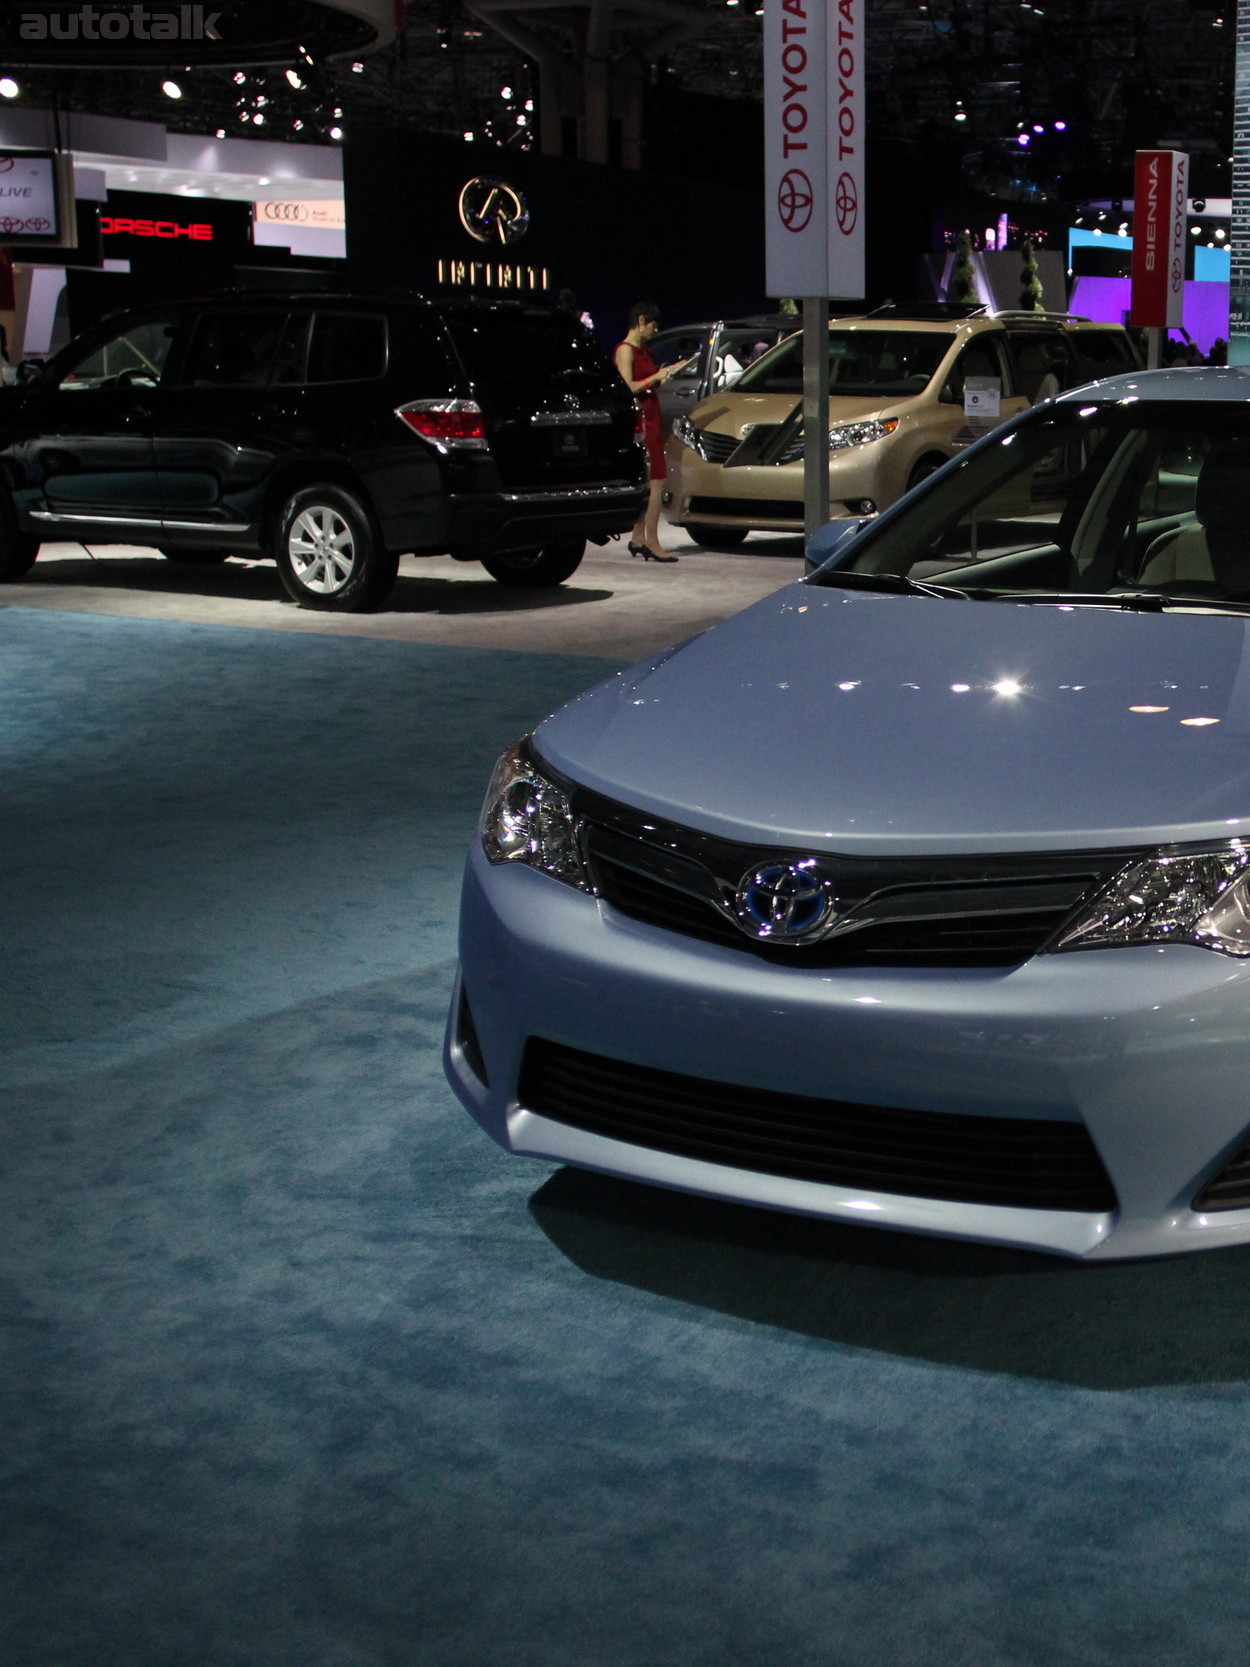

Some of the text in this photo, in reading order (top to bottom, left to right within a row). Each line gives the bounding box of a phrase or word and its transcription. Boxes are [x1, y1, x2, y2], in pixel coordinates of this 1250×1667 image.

[781, 0, 808, 159] TOYOTA
[838, 0, 855, 161] TOYOTA
[0, 187, 33, 198] LIVE
[99, 216, 214, 241] ORSCHE
[1145, 157, 1159, 271] SIENNA
[1174, 160, 1185, 252] TOYOTA
[437, 258, 549, 291] INFINITI
